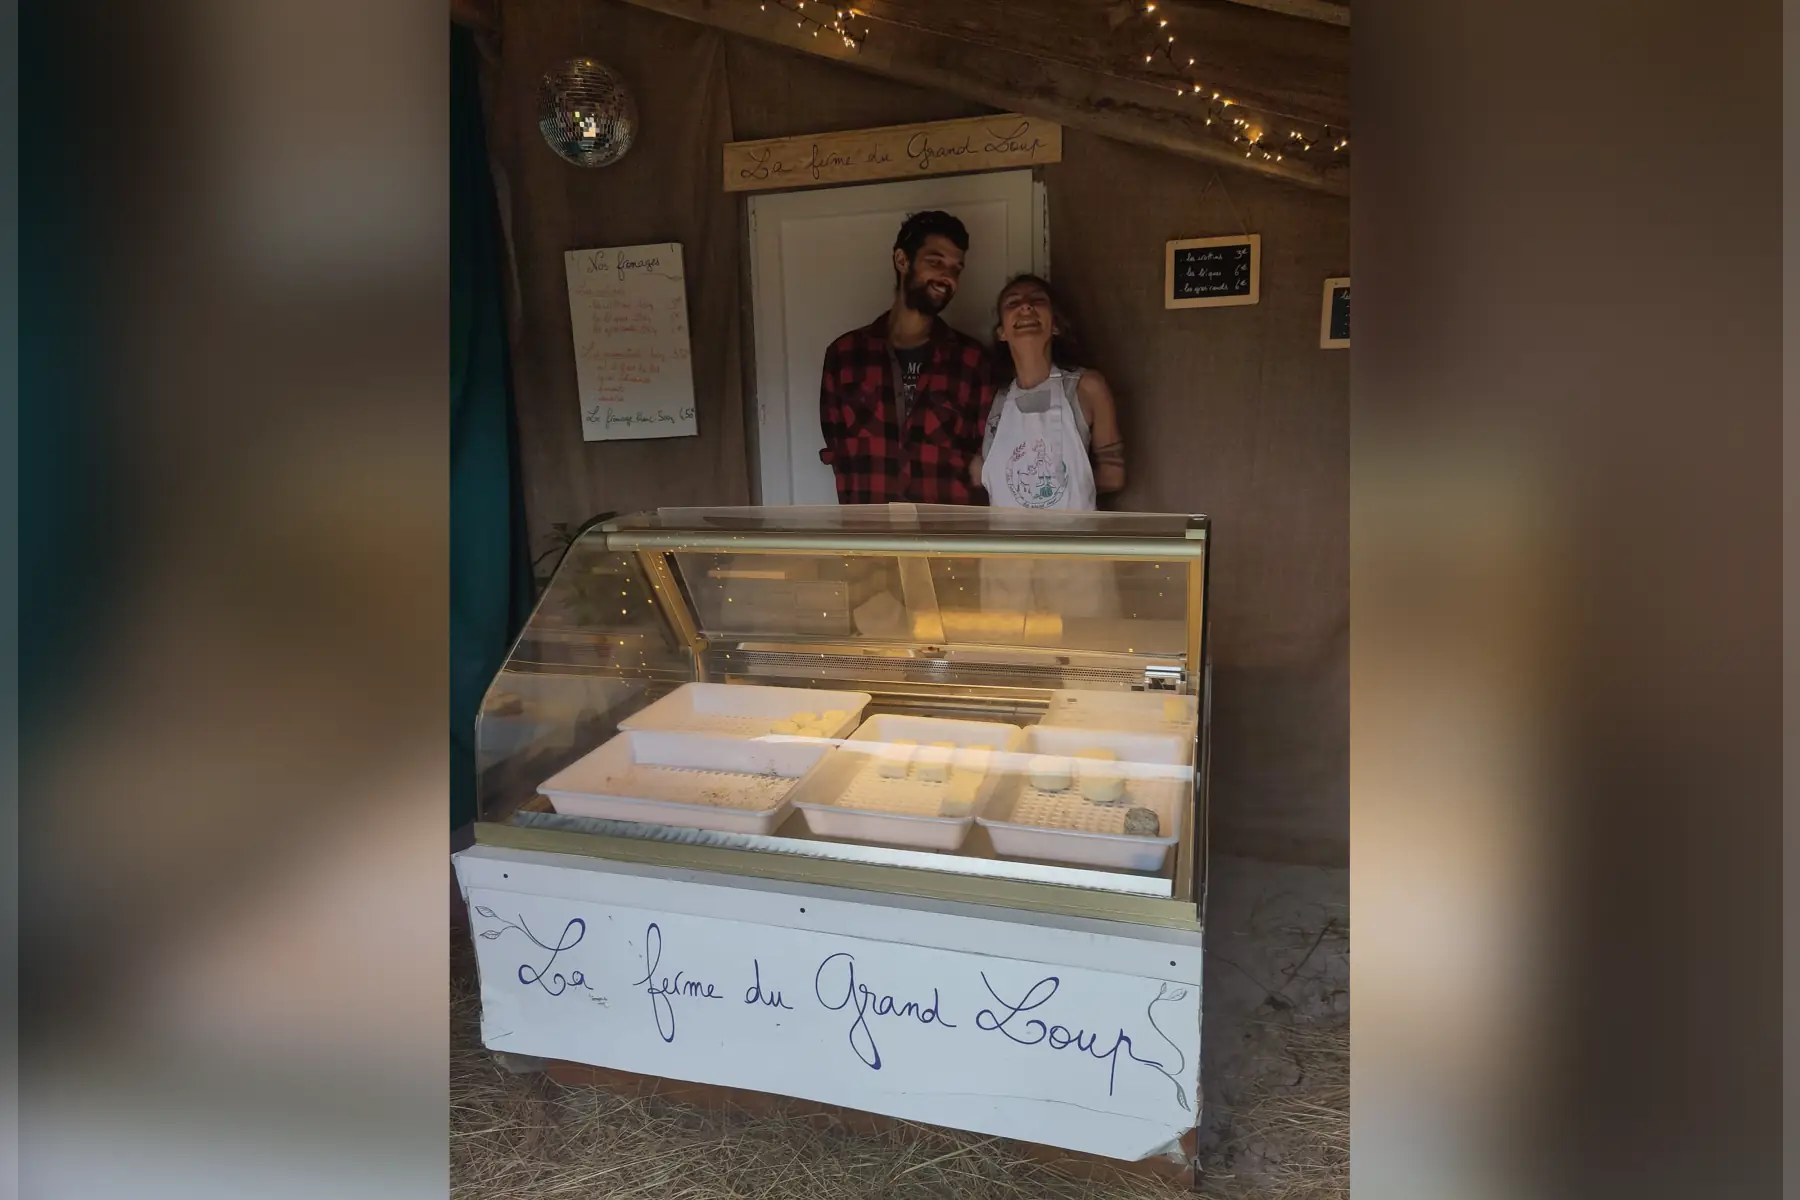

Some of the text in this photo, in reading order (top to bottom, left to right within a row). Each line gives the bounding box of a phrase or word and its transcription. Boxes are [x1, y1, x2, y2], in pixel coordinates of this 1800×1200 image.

[741, 121, 1048, 180] La ferme du Grand Loup
[587, 250, 660, 281] Nos fromages
[586, 406, 601, 423] Le
[517, 913, 1164, 1097] La ferme du Grand Loup
